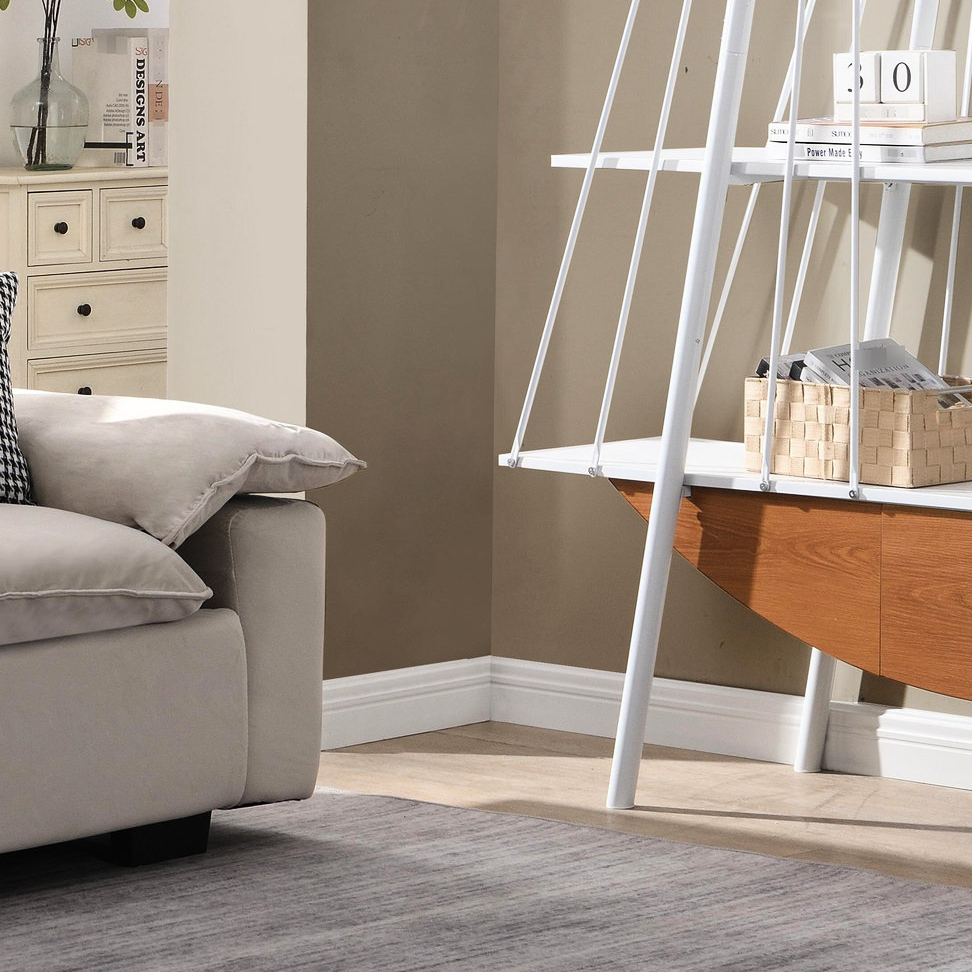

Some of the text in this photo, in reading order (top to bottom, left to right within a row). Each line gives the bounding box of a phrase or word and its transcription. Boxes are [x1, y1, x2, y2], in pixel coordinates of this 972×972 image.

[135, 58, 146, 163] DESIGNS ART
[806, 147, 827, 157] Power
[828, 147, 846, 157] Made
